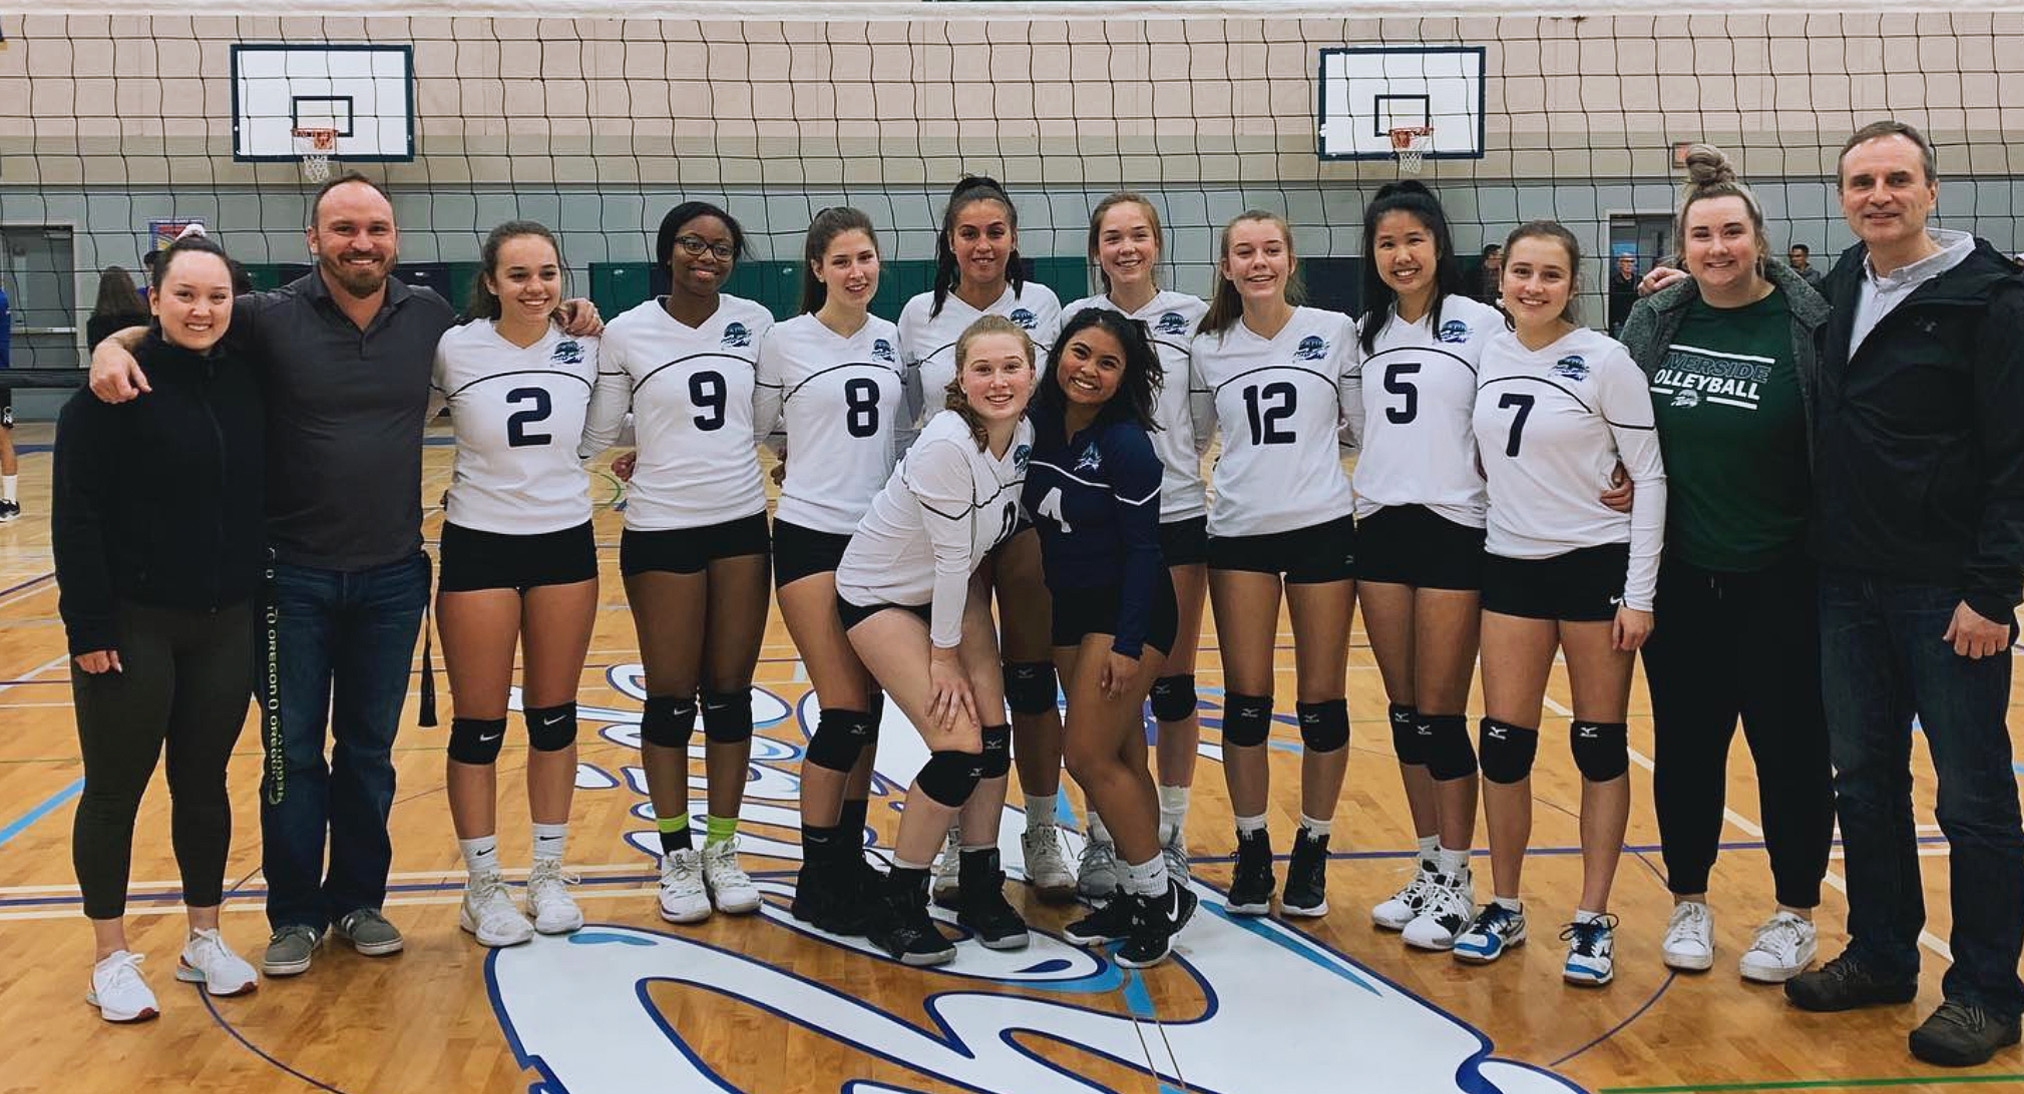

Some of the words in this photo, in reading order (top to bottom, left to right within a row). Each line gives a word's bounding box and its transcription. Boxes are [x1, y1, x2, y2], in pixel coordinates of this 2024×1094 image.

[689, 371, 727, 432] 9
[845, 378, 880, 437] 8
[1243, 382, 1297, 445] 12
[1384, 364, 1422, 424] 5
[1654, 368, 1760, 400] OLLEYBALL
[507, 388, 552, 447] 2
[1498, 393, 1535, 457] 7
